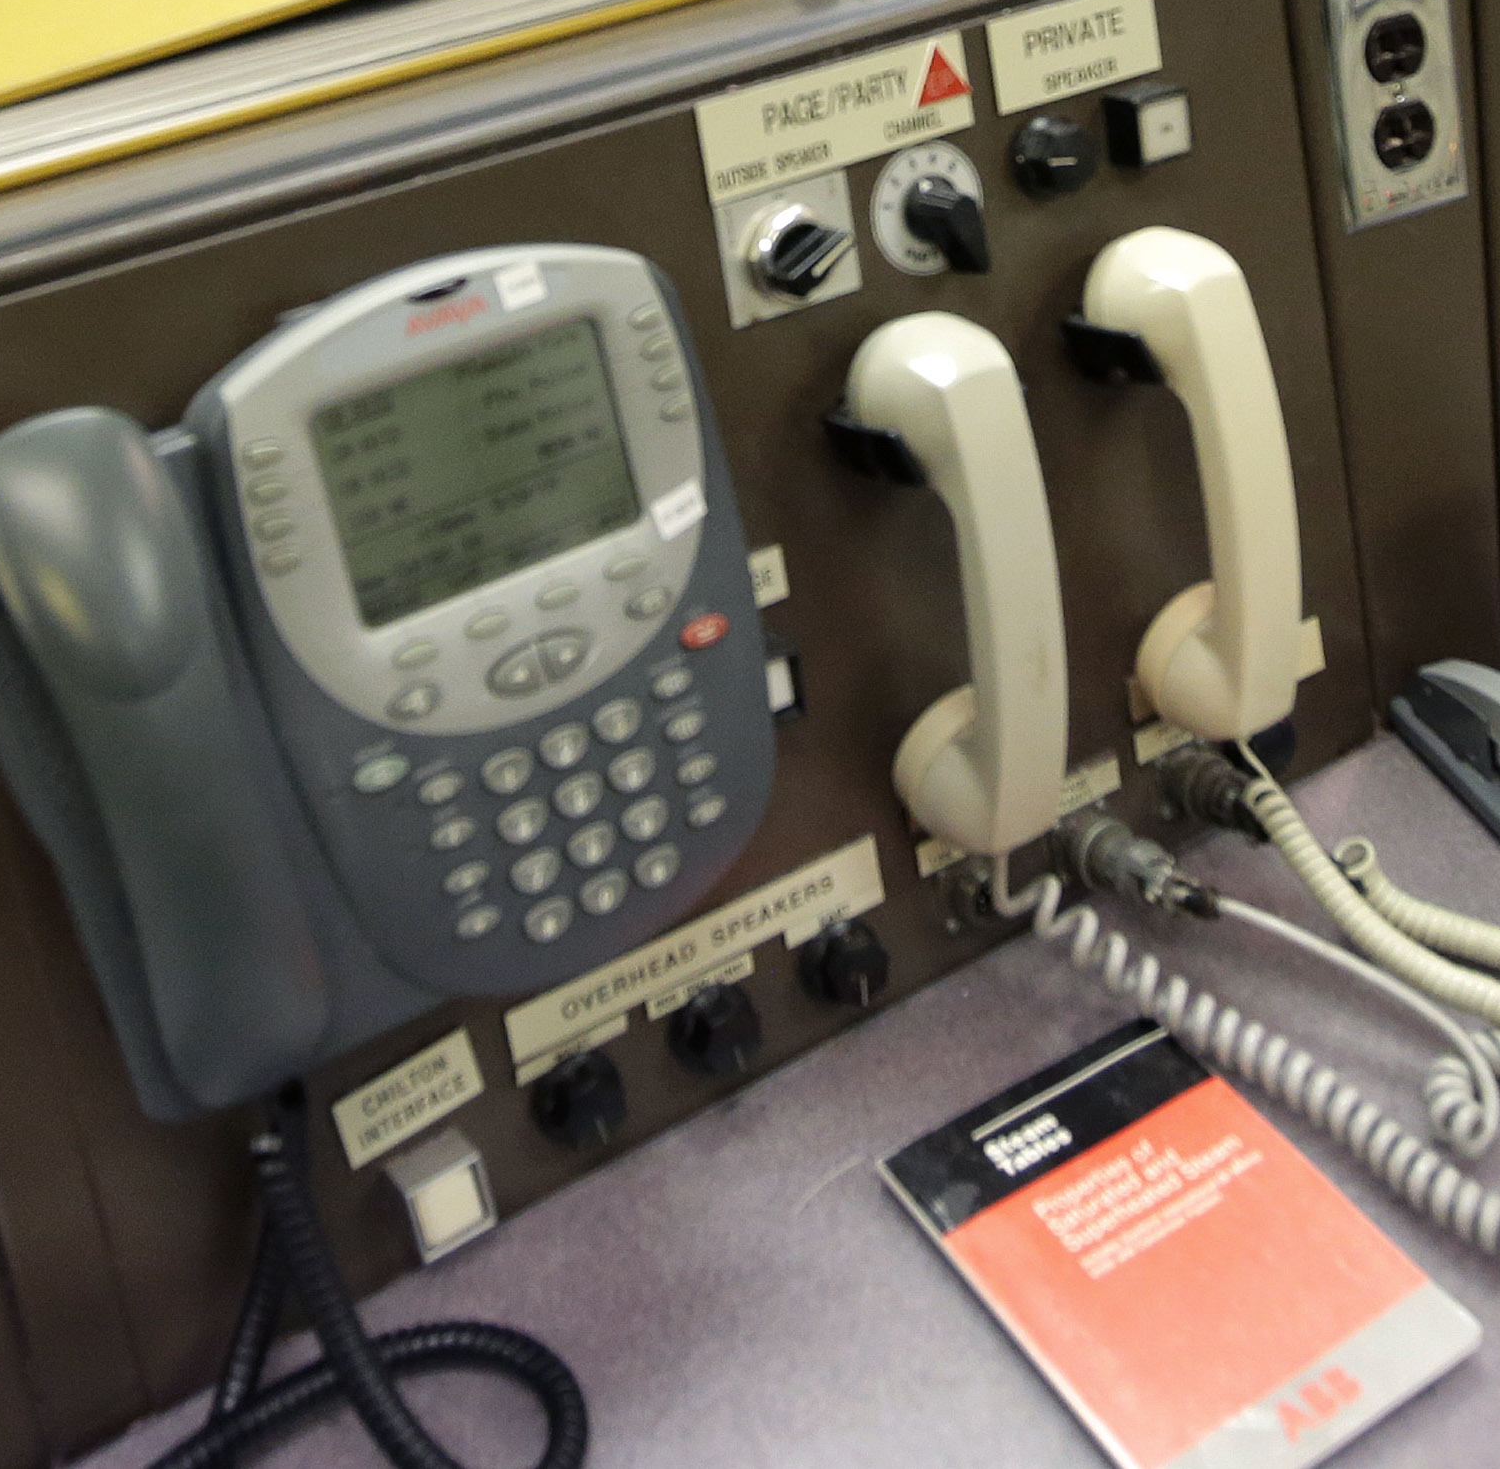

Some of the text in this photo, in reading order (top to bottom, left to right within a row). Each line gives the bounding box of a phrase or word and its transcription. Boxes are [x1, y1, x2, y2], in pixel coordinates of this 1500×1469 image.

[1022, 6, 1128, 58] PRIVATE
[760, 66, 908, 134] PAGE/PARTY
[1043, 55, 1120, 94] SPEAKER
[560, 941, 699, 1021] OVERHEAD
[710, 874, 835, 949] SPEAKERS
[357, 1076, 466, 1148] INTERFACE
[361, 1054, 451, 1115] CHILTON
[983, 1112, 1060, 1168] Steam
[999, 1125, 1074, 1177] Tables
[1031, 1137, 1156, 1218] Properties of
[1044, 1168, 1143, 1236] Saturated
[1059, 1169, 1184, 1253] Superheated
[1273, 1365, 1364, 1446] ABB
